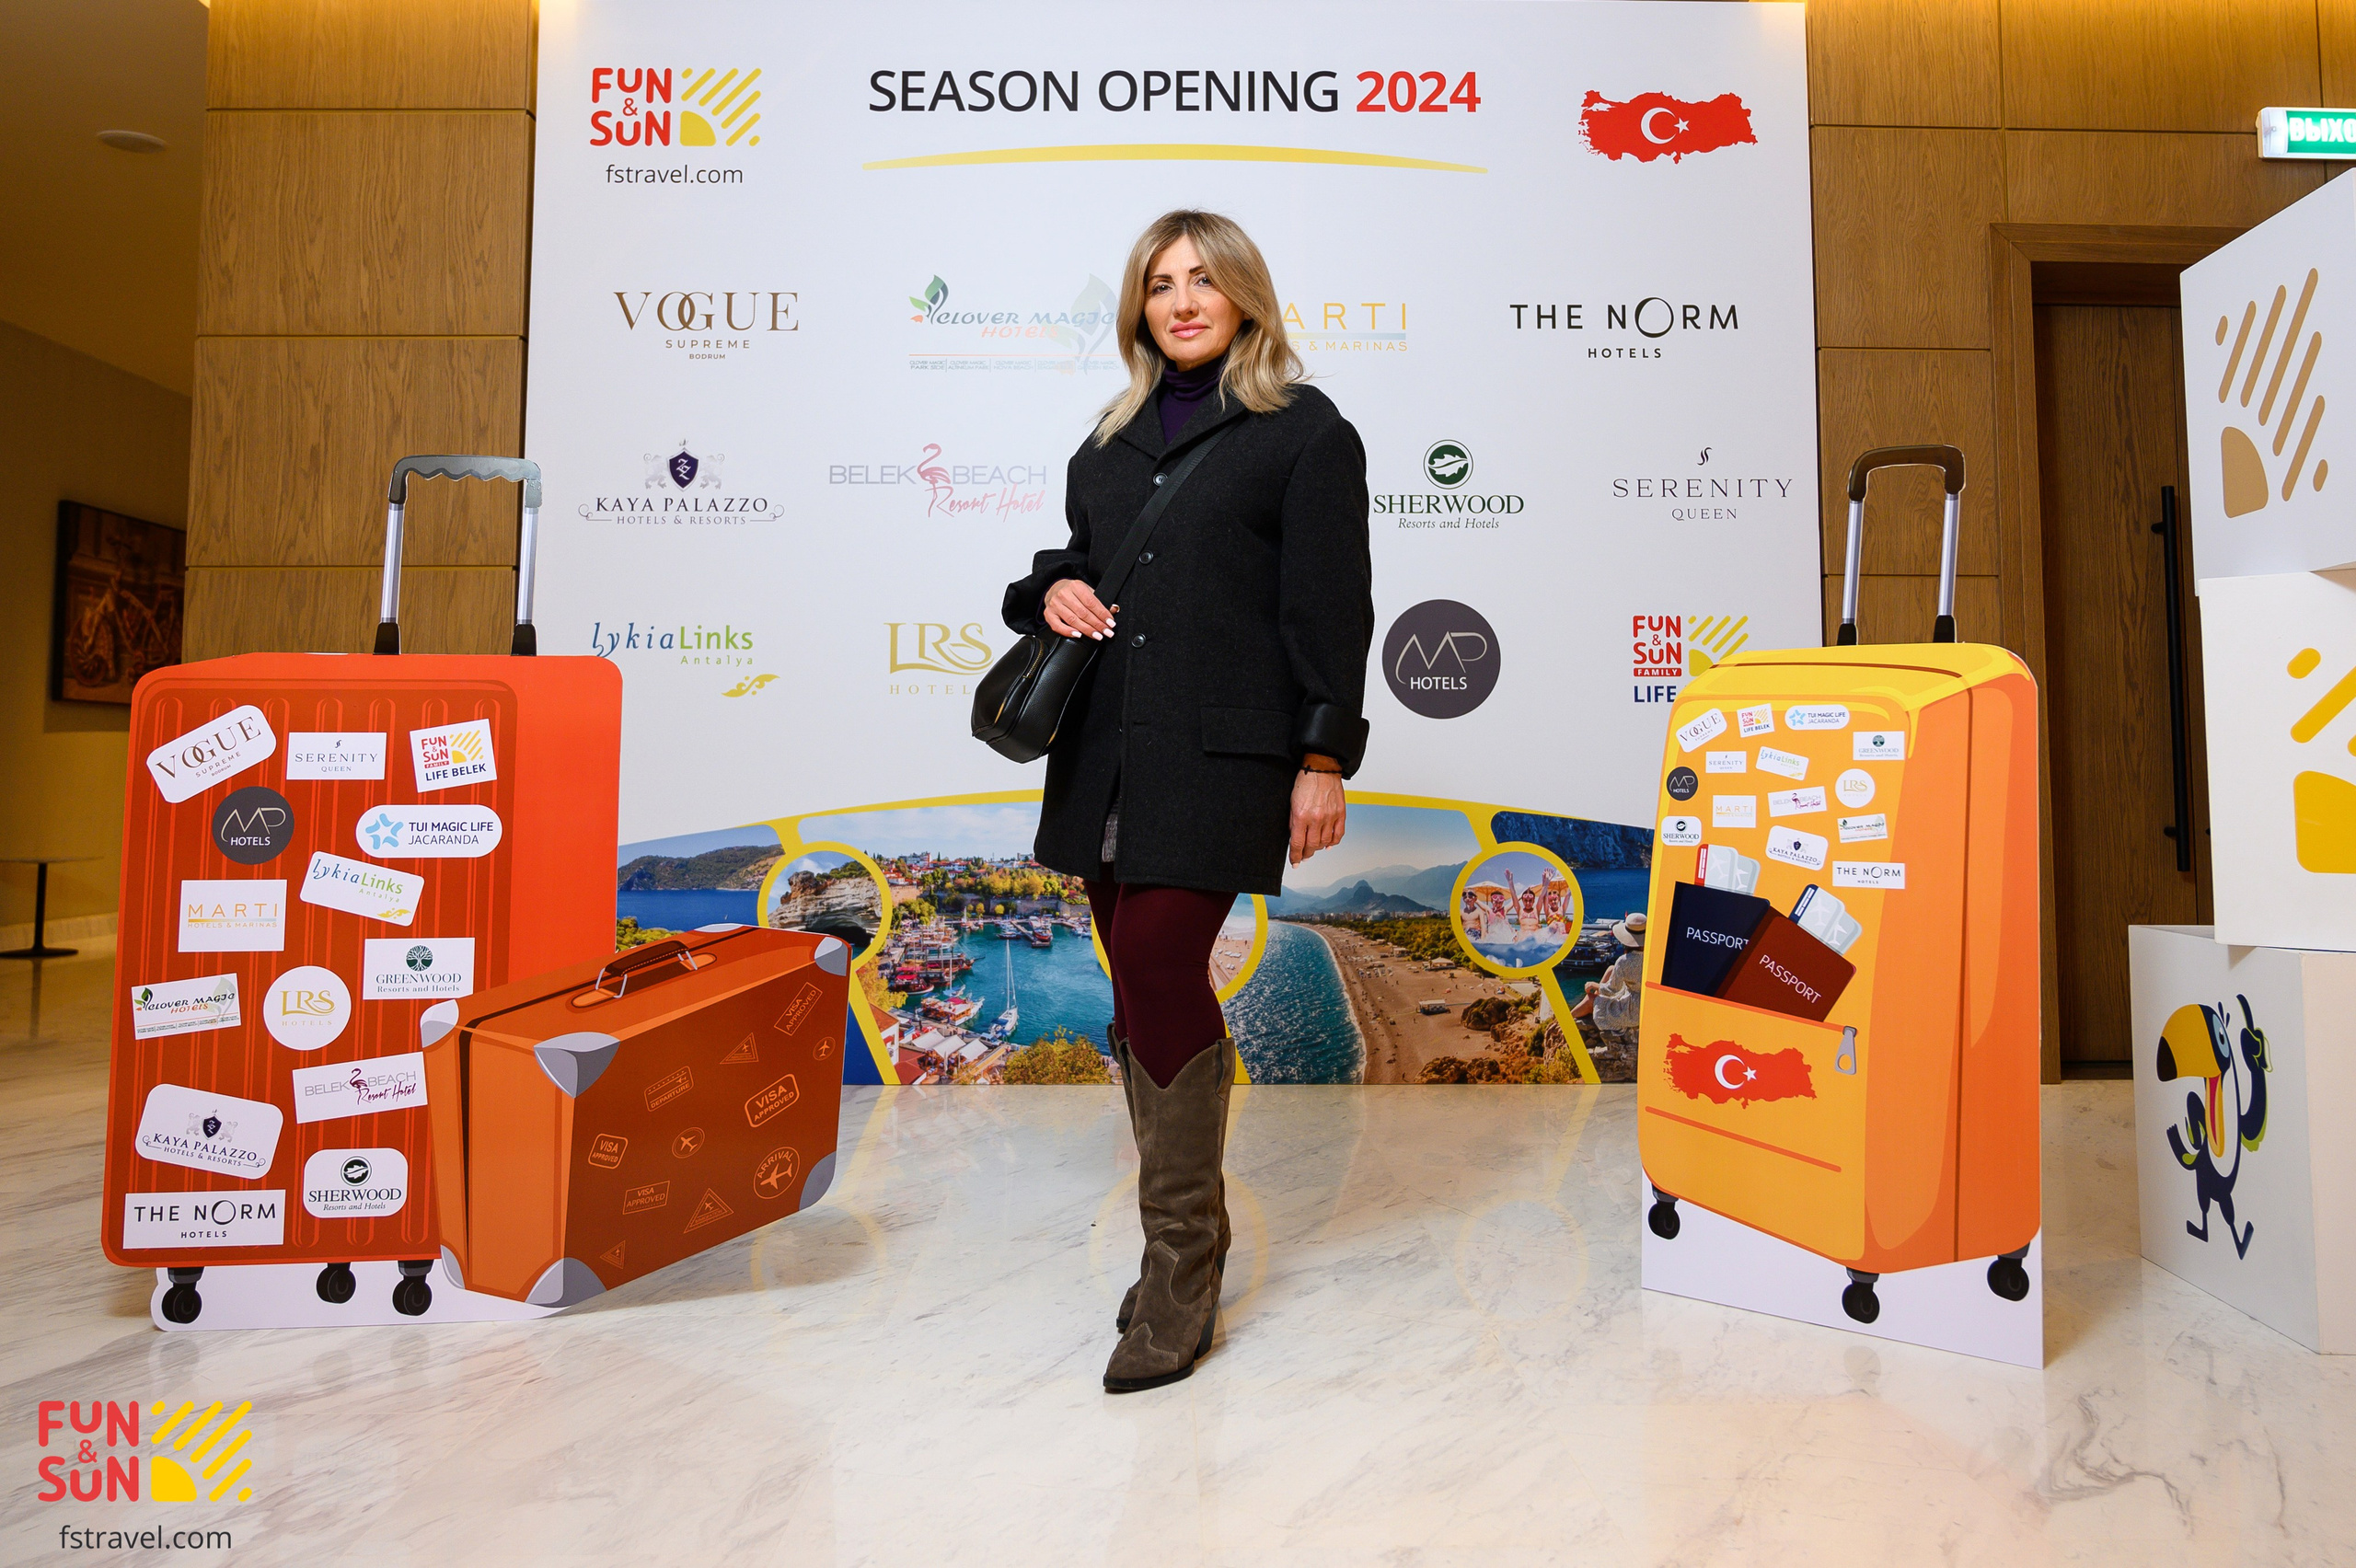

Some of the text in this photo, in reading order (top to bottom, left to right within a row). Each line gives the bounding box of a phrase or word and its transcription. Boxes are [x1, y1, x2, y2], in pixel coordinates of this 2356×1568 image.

[592, 67, 672, 104] FUN
[869, 69, 1482, 112] SEASON OPENING 2024
[622, 98, 639, 116] &
[589, 110, 671, 146] SUN
[2289, 117, 2356, 143] ВЫХО
[606, 164, 744, 184] fstravel.com
[613, 291, 799, 331] VOGUE
[1282, 303, 1406, 330] ARTI
[1509, 296, 1738, 339] THE NORM
[936, 311, 1116, 329] CLOVER MAGIC
[980, 326, 1059, 339] HOTELS
[665, 340, 750, 349] SUPREME
[1309, 341, 1319, 351] &
[1325, 341, 1408, 352] MARINAS
[1588, 348, 1662, 358] HOTELS
[829, 465, 1046, 485] BELEK BEACH
[1612, 478, 1793, 498] SERENITY
[595, 497, 768, 513] KAYA PALAZZO
[924, 483, 1045, 523] Resort Hotel
[1373, 494, 1524, 514] SHERWOOD
[617, 515, 746, 525] HOTELS & RESORTS
[1398, 517, 1500, 529] Resorts and Hotels
[1671, 508, 1738, 521] QUEEN
[1633, 616, 1681, 638] FUN
[884, 622, 995, 675] LRS
[1652, 634, 1662, 646] &
[680, 654, 754, 667] Antalya
[1634, 641, 1682, 664] SUN
[1637, 668, 1678, 676] FAMILY
[889, 685, 972, 695] HOTEL
[1410, 676, 1468, 690] HOTELS
[1634, 686, 1677, 702] LIFE
[1680, 713, 1721, 742] VOGUE
[156, 717, 261, 778] VOGUE
[421, 735, 447, 750] FUN
[294, 753, 379, 763] SERENITY
[422, 748, 449, 763] SUN
[195, 751, 241, 778] SUPREME
[425, 763, 487, 781] LIFE BELEK
[409, 822, 494, 832] TUI MAGIC LIFE
[230, 836, 271, 847] HOTELS
[409, 835, 479, 845] JACARANDA
[1773, 847, 1788, 855] KAYA
[1790, 851, 1818, 862] PALAZZO
[312, 859, 404, 895] lykiaLinks
[1836, 866, 1901, 879] THE NORM
[358, 888, 401, 903] Antalya
[188, 903, 278, 917] MARTI
[375, 973, 462, 985] GREENWOOD
[1759, 954, 1822, 1004] PASSPORT
[376, 985, 460, 993] Resorts and Hotels
[147, 993, 236, 1010] CLOVER MAGIC
[170, 1003, 209, 1014] HOTELS
[280, 990, 337, 1017] LRS
[785, 998, 803, 1017] VISA
[786, 989, 816, 1031] APPROVED
[305, 1070, 417, 1097] BELEK BEACH
[355, 1082, 417, 1105] Resort Hotel
[651, 1083, 690, 1108] DEPARTURE
[756, 1085, 787, 1109] VISA
[754, 1091, 794, 1122] APPROVED
[153, 1133, 258, 1161] KAYA PALAZZO
[599, 1140, 619, 1153] VISA
[163, 1147, 194, 1159] HOTELS
[206, 1155, 242, 1167] RESORTS
[592, 1152, 618, 1163] APPROVED
[756, 1150, 794, 1179] ARRIVAL
[307, 1188, 402, 1203] SHERWOOD
[626, 1193, 665, 1207] APPROVED
[637, 1187, 654, 1196] VISA
[134, 1199, 276, 1226] THE NORM
[323, 1202, 387, 1212] Resorts and Hotels
[180, 1230, 227, 1239] HOTELS
